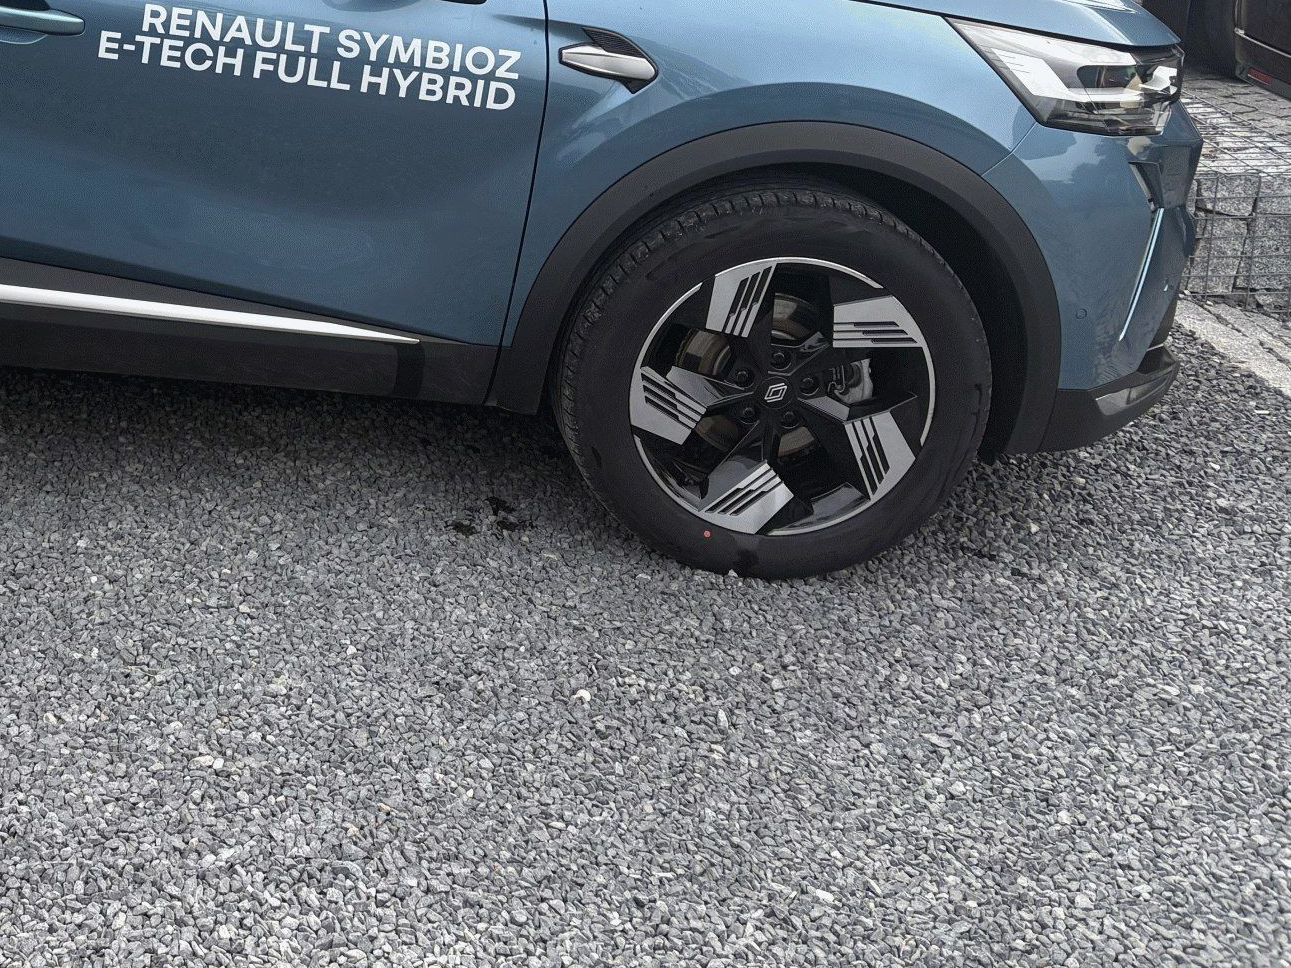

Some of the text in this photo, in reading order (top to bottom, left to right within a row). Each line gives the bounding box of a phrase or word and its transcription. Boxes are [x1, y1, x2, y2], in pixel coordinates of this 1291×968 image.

[97, 30, 516, 111] E-TECH FULL HYBRID
[142, 3, 523, 79] RENAULT SYMBIOZ
